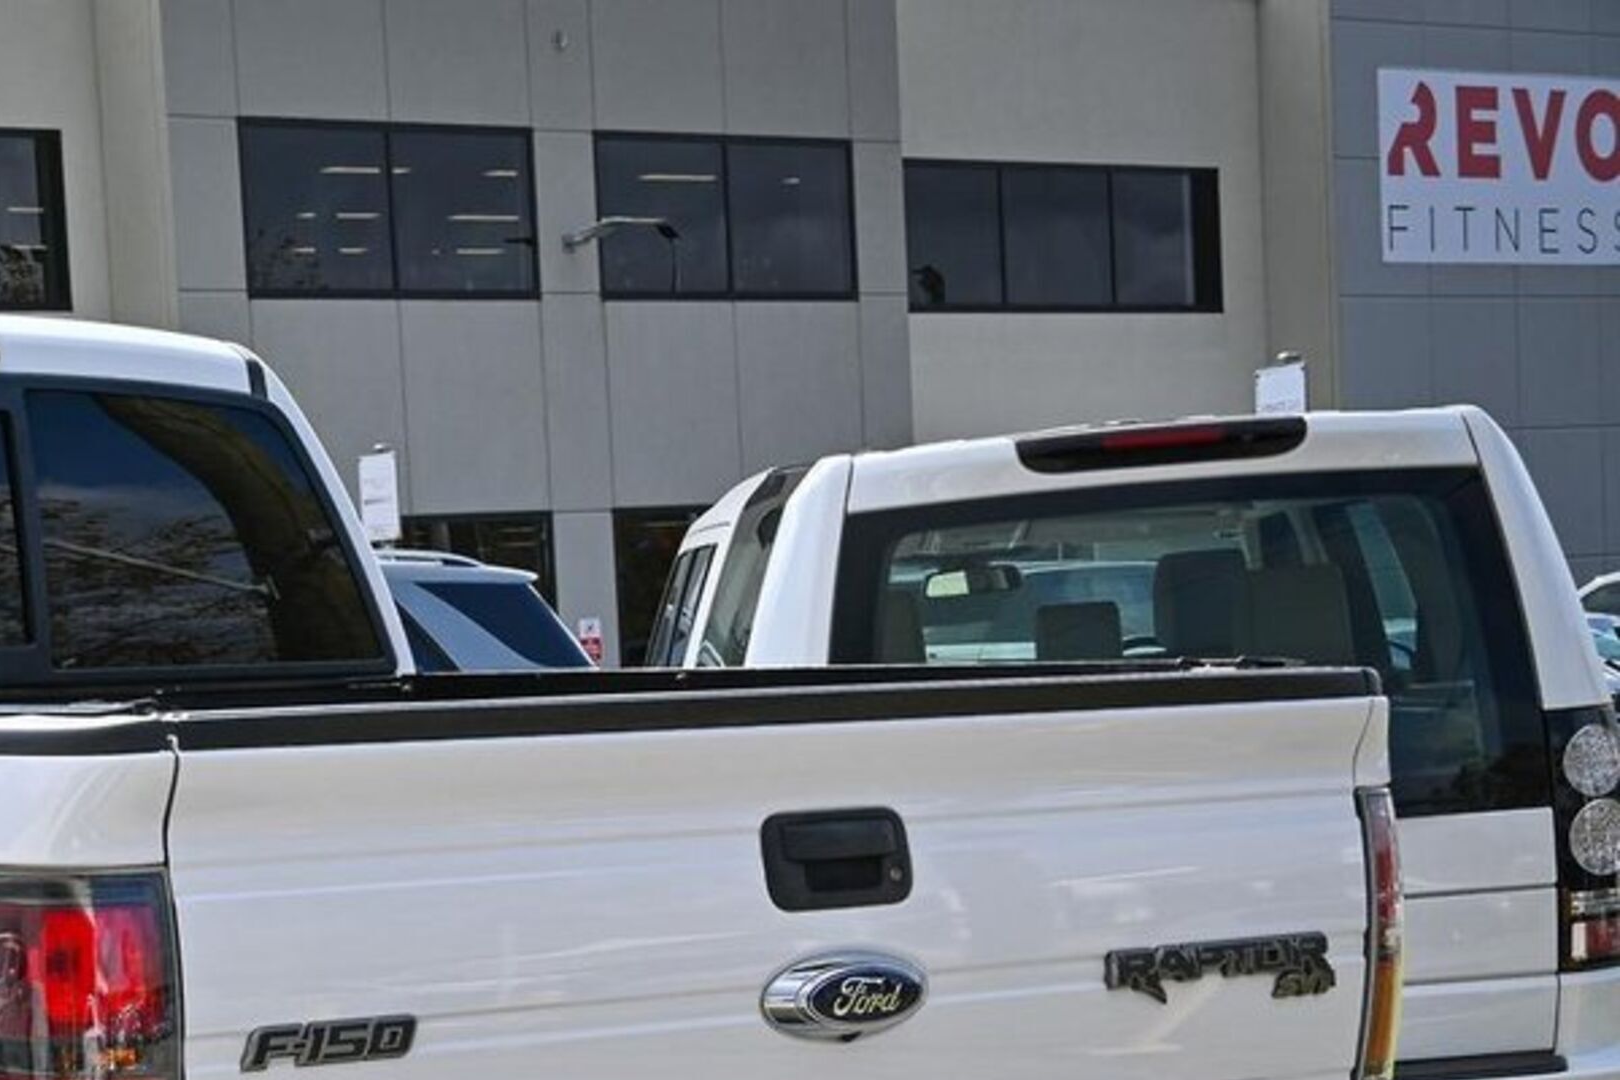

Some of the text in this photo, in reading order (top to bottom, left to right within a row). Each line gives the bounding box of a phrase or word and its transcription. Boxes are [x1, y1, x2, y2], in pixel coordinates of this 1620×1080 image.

[1387, 81, 1620, 182] REVO
[833, 976, 902, 1016] Ford
[1104, 931, 1335, 1003] RAPTOR
